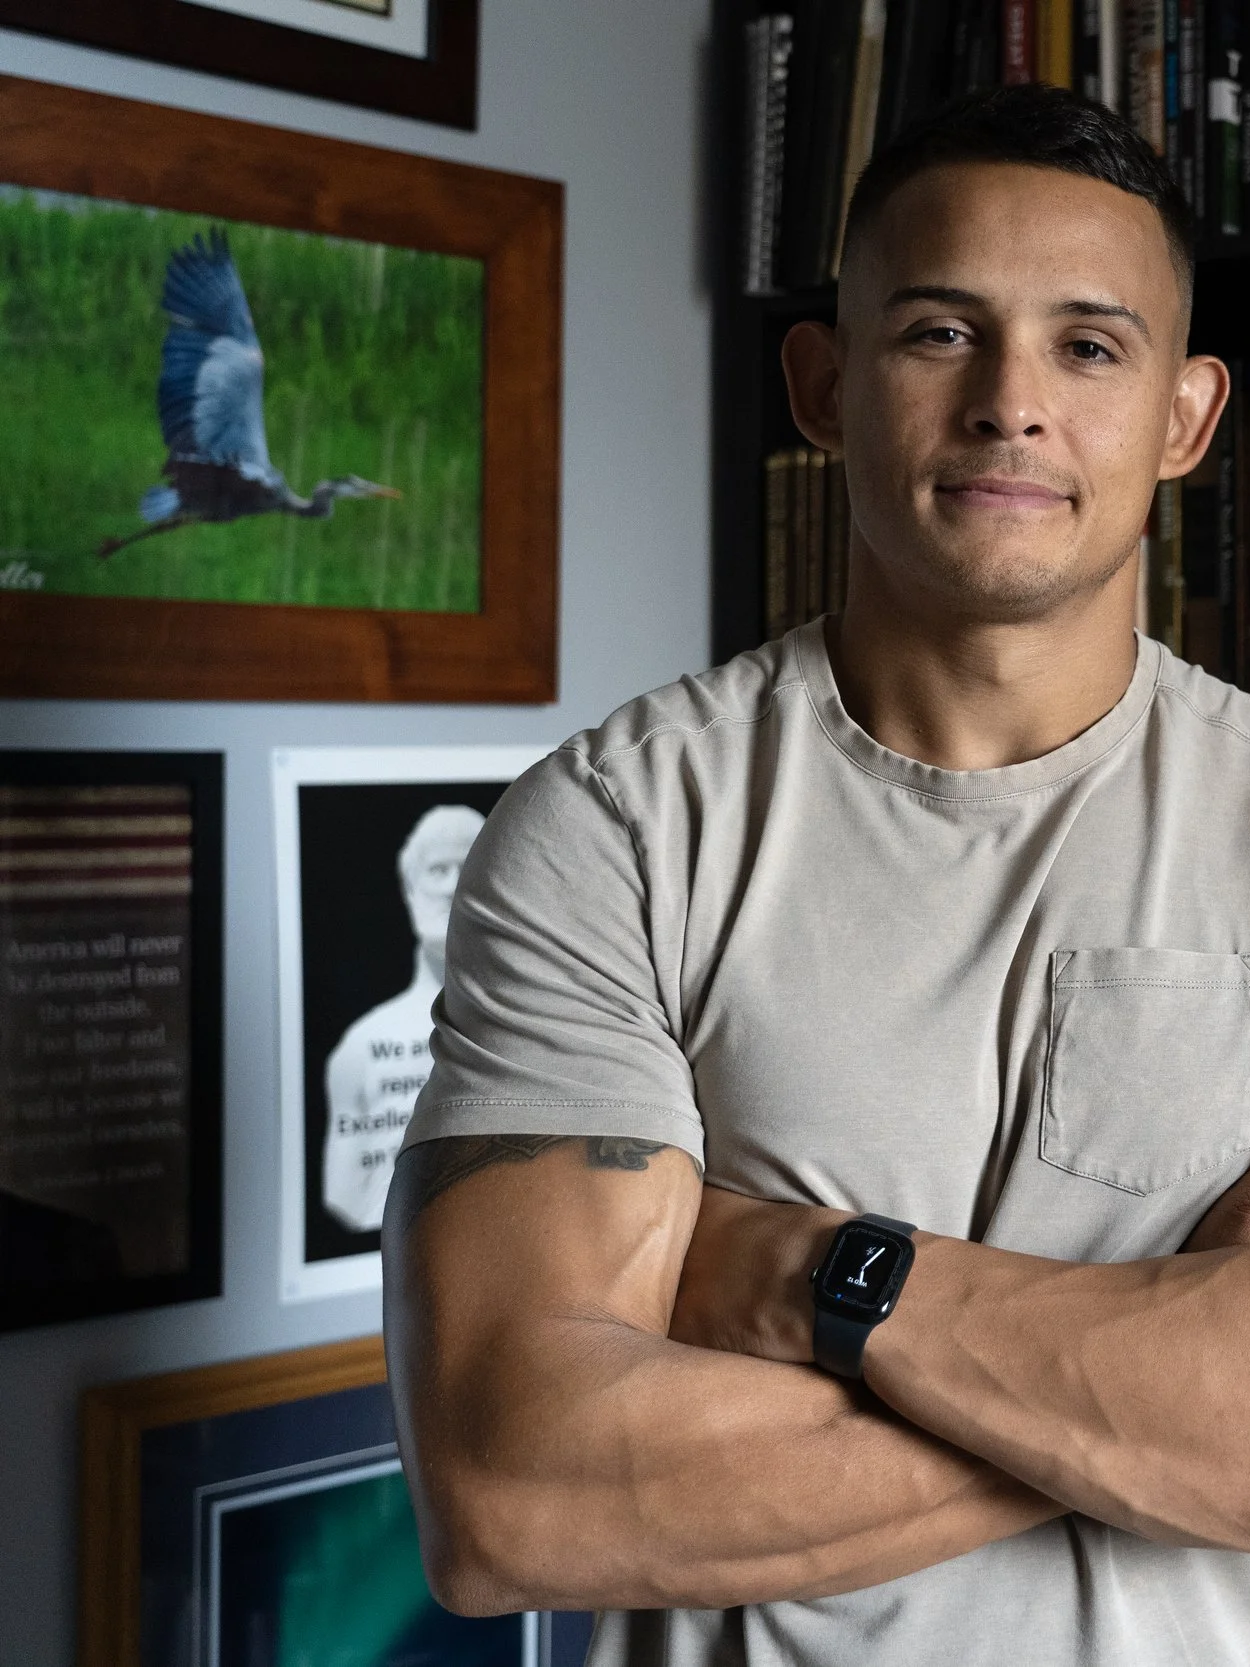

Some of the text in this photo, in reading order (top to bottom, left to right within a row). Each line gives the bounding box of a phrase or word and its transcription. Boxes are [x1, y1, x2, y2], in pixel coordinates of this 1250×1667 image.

[91, 933, 126, 959] will
[129, 935, 184, 956] never
[135, 963, 181, 986] from
[370, 1041, 404, 1060] We
[361, 1148, 386, 1168] an
